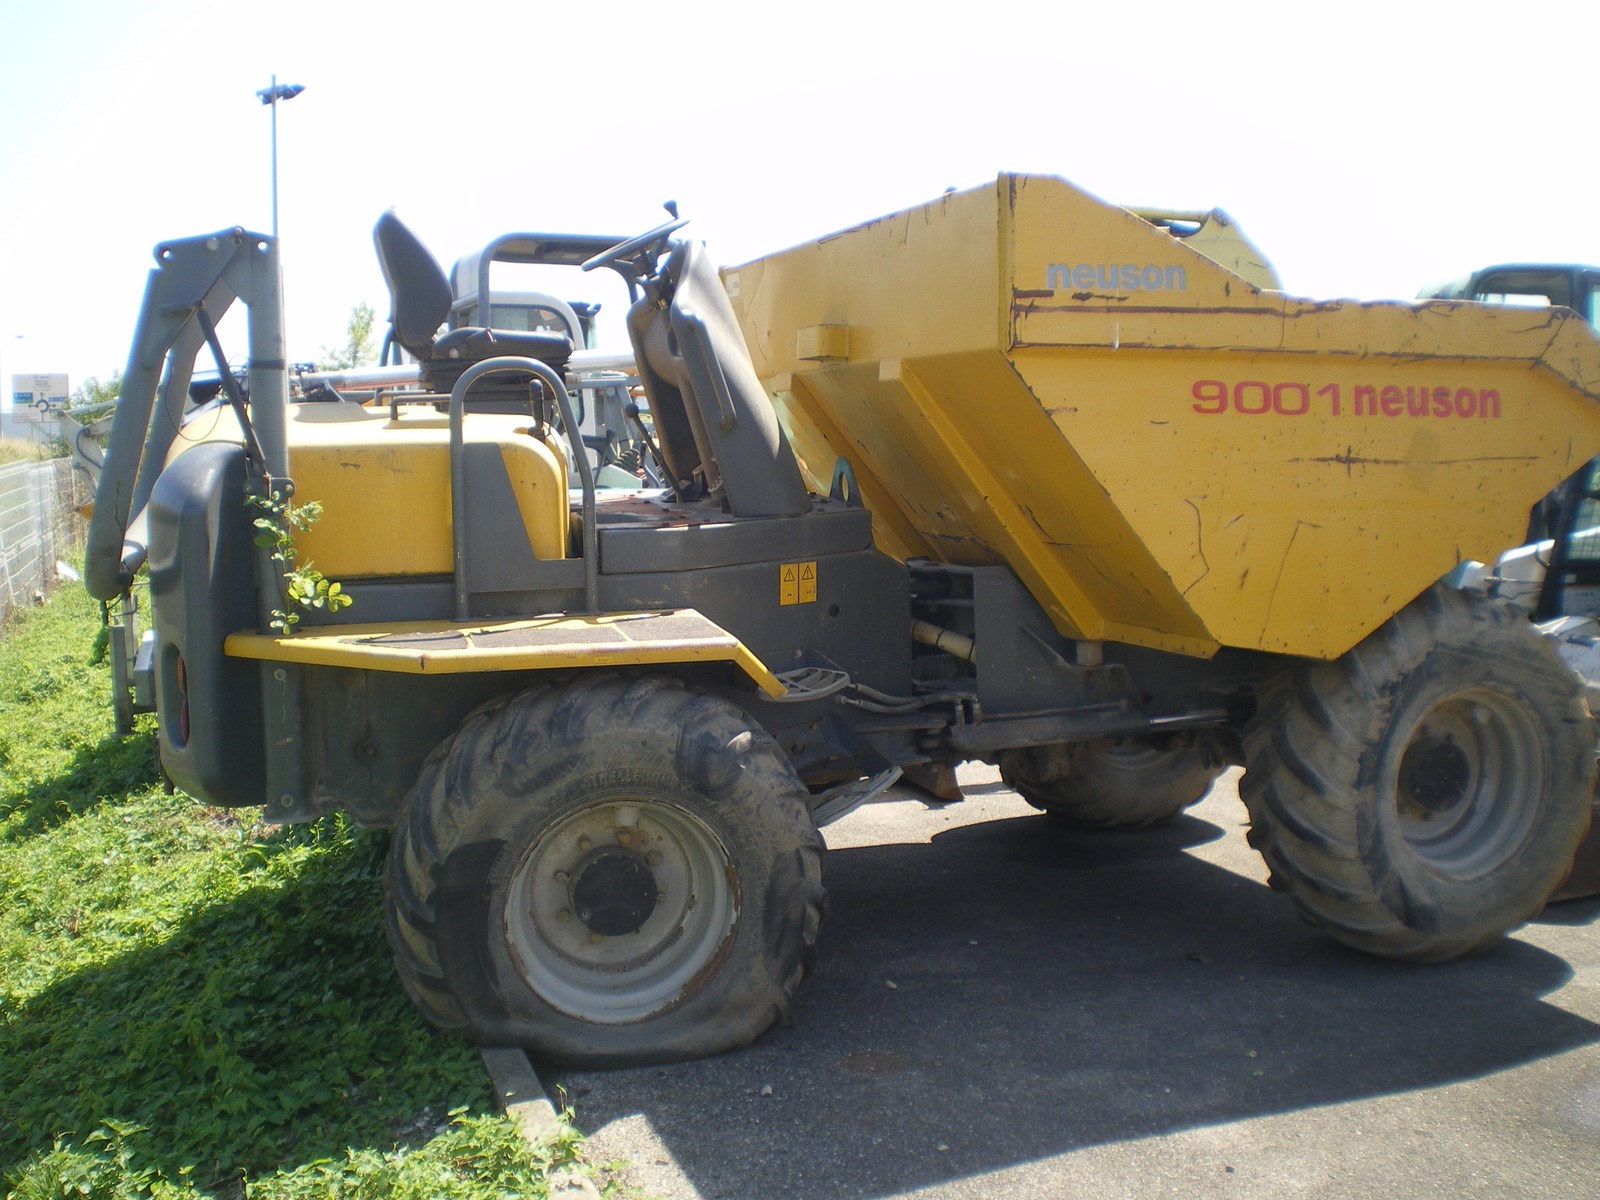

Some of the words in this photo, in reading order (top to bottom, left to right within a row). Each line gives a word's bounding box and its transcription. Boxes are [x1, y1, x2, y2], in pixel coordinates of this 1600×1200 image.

[1048, 263, 1187, 290] neuson
[1192, 379, 1341, 416] 9001
[1354, 384, 1502, 418] neuson
